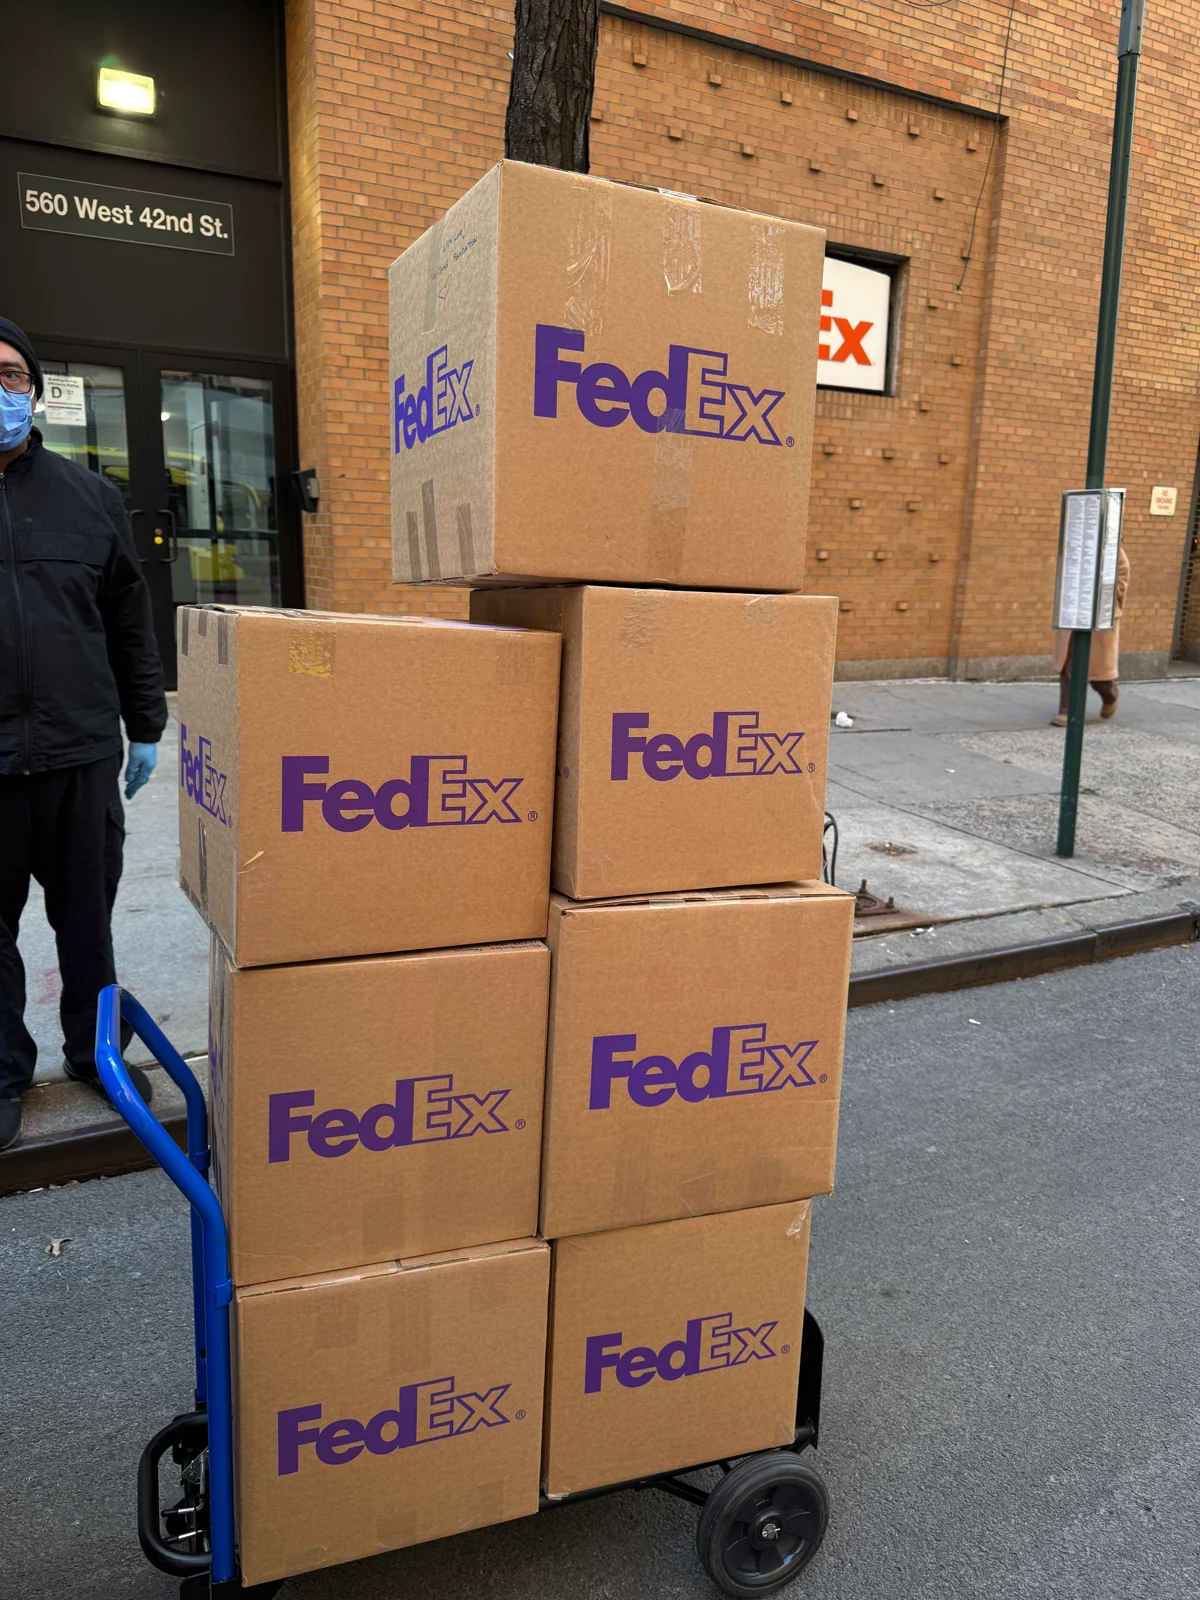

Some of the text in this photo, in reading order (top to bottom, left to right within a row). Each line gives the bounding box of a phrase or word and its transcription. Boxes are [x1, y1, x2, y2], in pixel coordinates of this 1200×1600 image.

[25, 190, 229, 239] 560 West 42nd St.
[51, 386, 62, 398] D
[394, 344, 474, 455] FedEx
[533, 324, 786, 446] FedEx
[180, 722, 228, 826] FedEx
[611, 711, 804, 781] FedEx
[281, 755, 524, 832] FedEx
[589, 1023, 819, 1111] FedEx
[268, 1074, 511, 1163] FedEx
[584, 1312, 779, 1394] FedEx
[277, 1375, 511, 1476] FedEx
